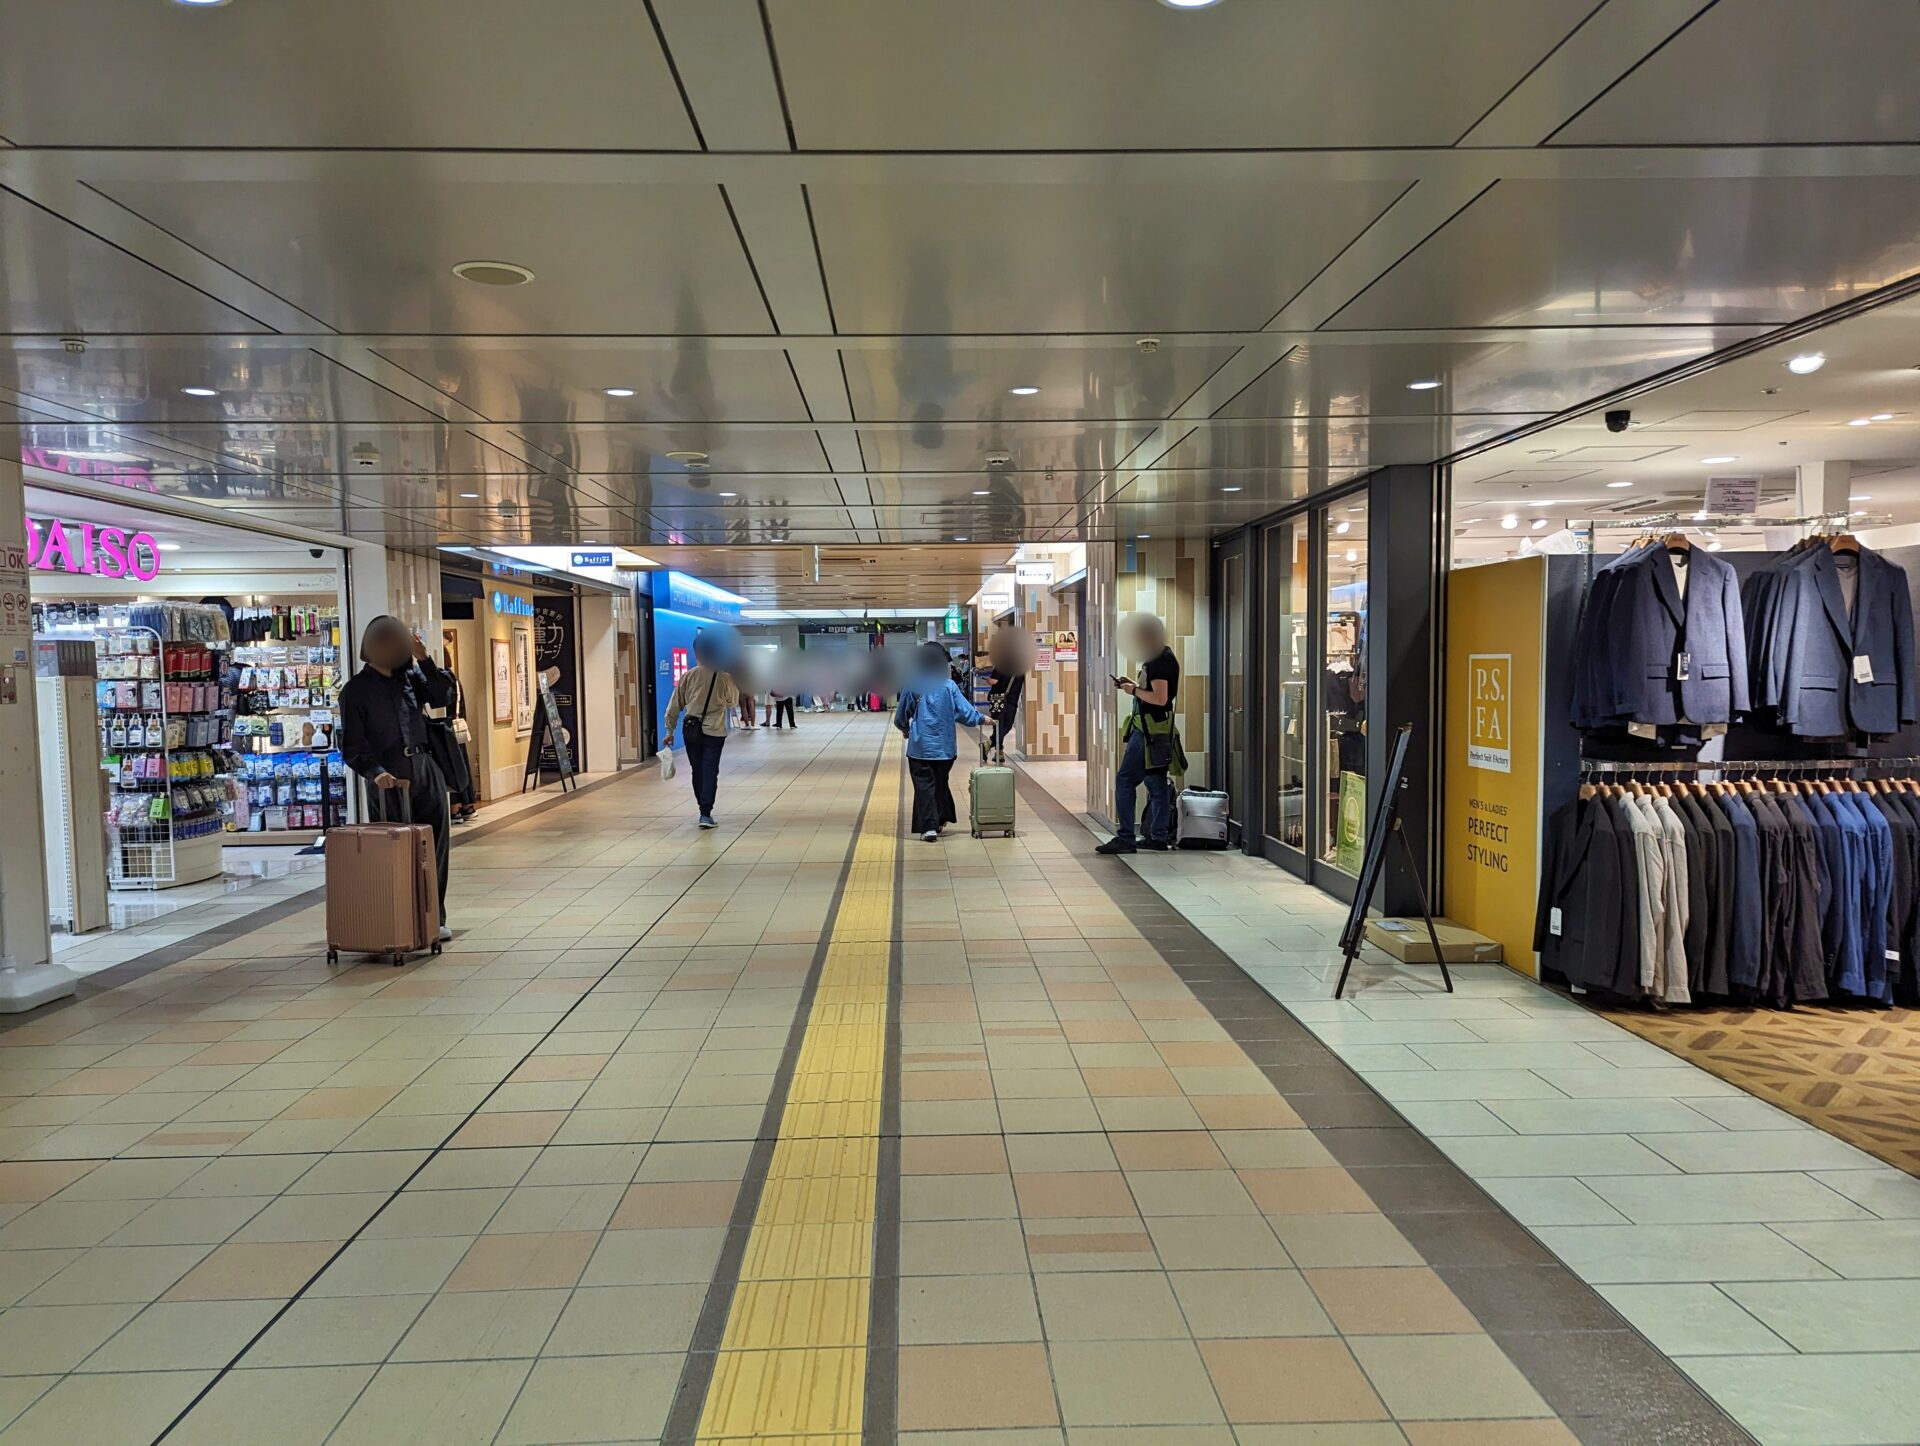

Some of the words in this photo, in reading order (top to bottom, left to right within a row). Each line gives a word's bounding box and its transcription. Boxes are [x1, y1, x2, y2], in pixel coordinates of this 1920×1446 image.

[9, 553, 24, 569] OK
[503, 594, 534, 616] Raffine
[1475, 668, 1504, 701] P.S.
[1475, 706, 1503, 740] FA
[1469, 750, 1483, 761] Perfect
[1483, 752, 1492, 763] Suit
[1469, 799, 1483, 810] MEN'S
[1468, 817, 1508, 844] PERFECT
[1467, 844, 1508, 872] STYLING
